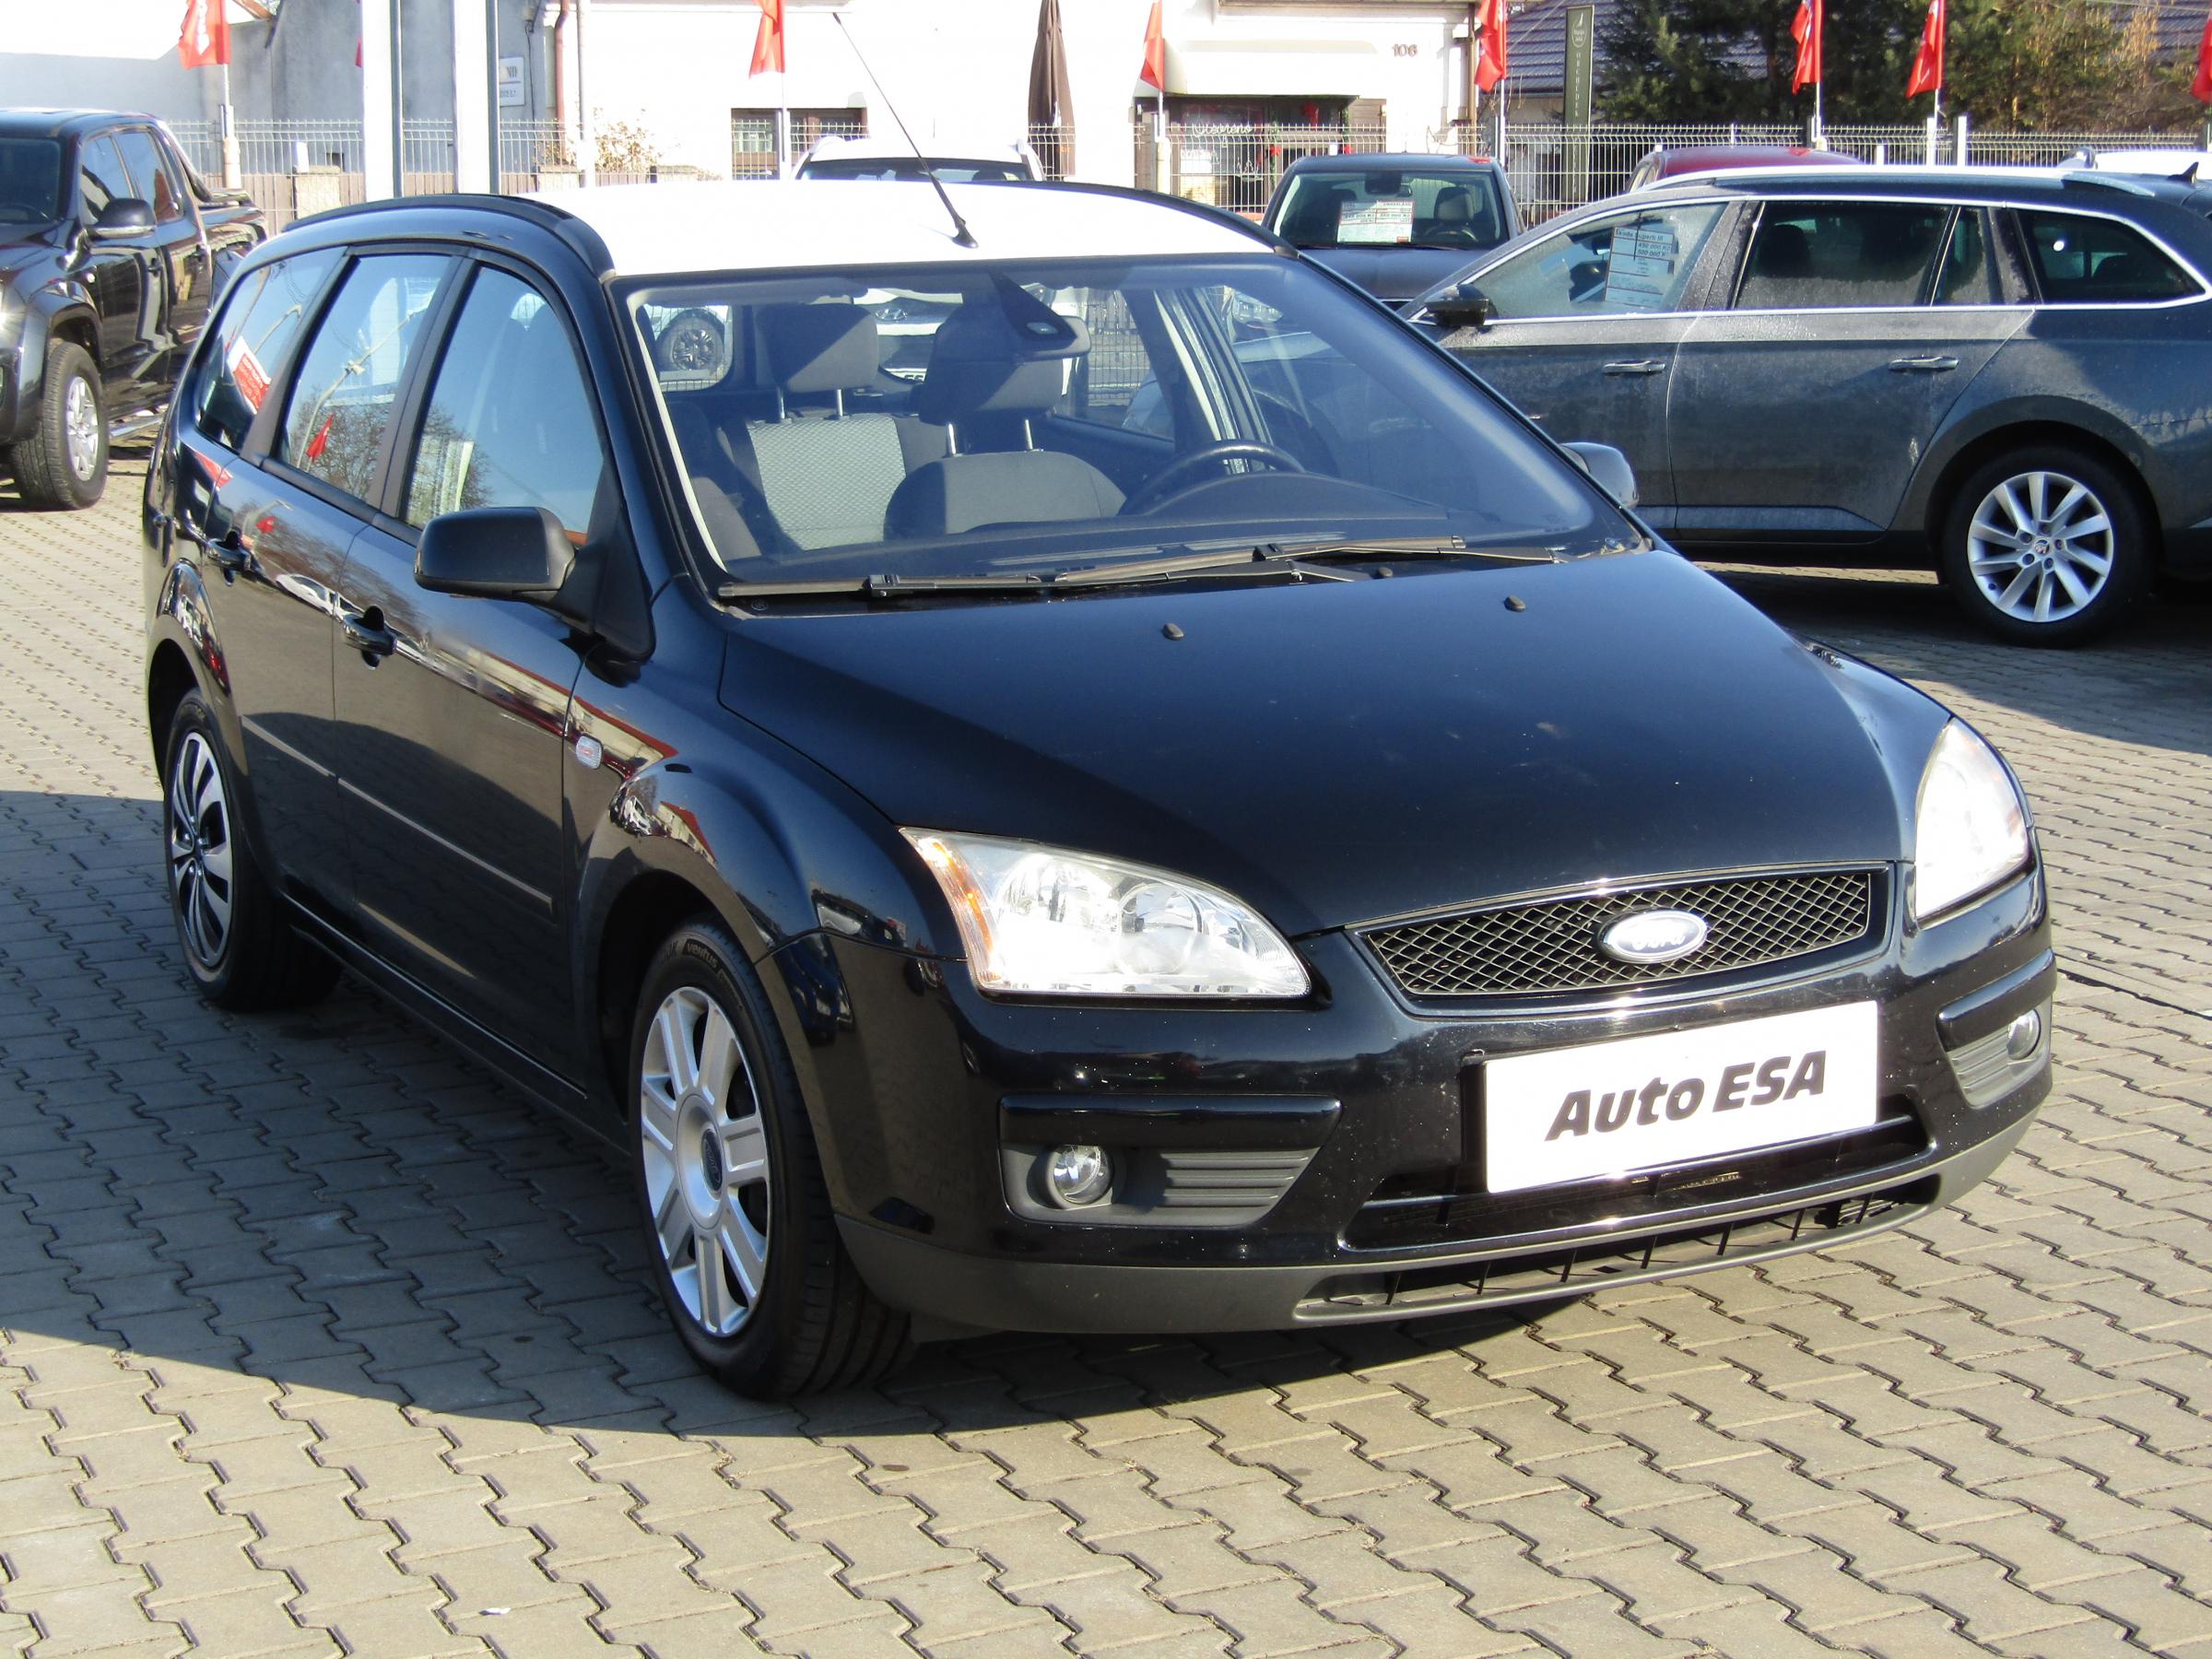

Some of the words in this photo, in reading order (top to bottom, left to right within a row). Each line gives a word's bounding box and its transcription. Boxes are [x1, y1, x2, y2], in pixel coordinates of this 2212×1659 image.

[1392, 43, 1418, 57] 106
[1545, 1077, 1704, 1142] Auto
[1712, 1051, 1826, 1112] ESA
